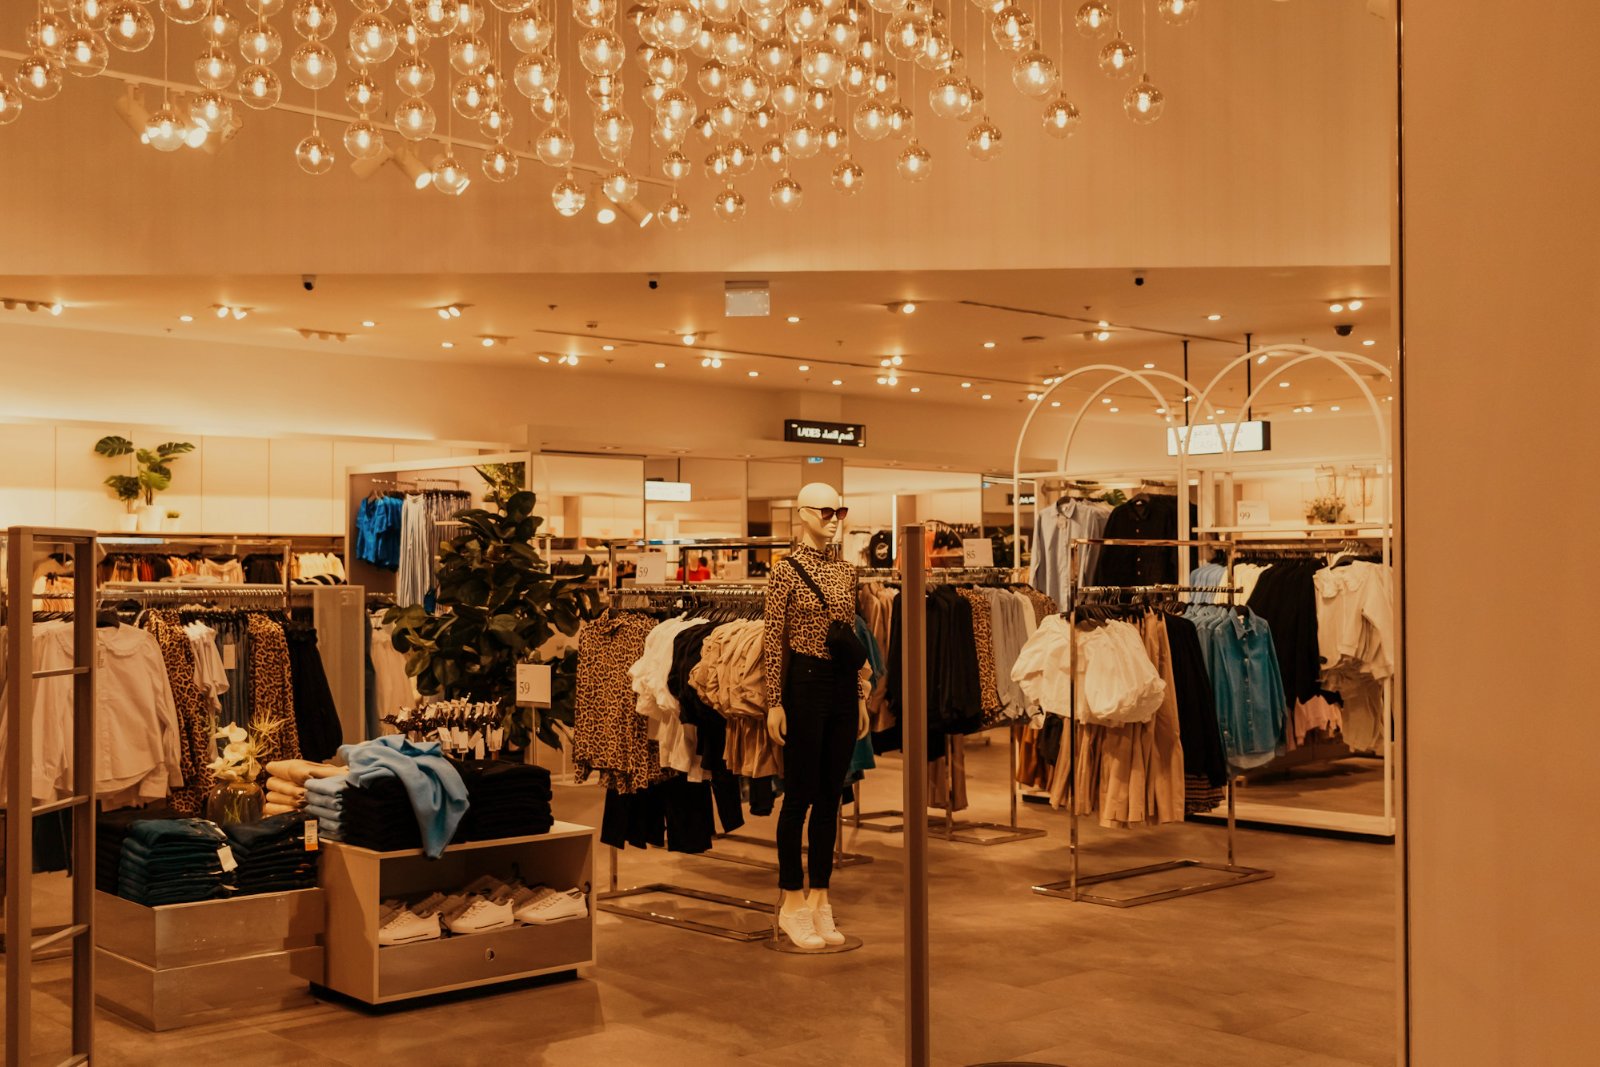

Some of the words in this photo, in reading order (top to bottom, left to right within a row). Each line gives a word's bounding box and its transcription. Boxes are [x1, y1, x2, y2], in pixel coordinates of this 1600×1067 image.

[966, 550, 976, 560] 85
[638, 566, 649, 578] 59
[519, 681, 531, 695] 59
